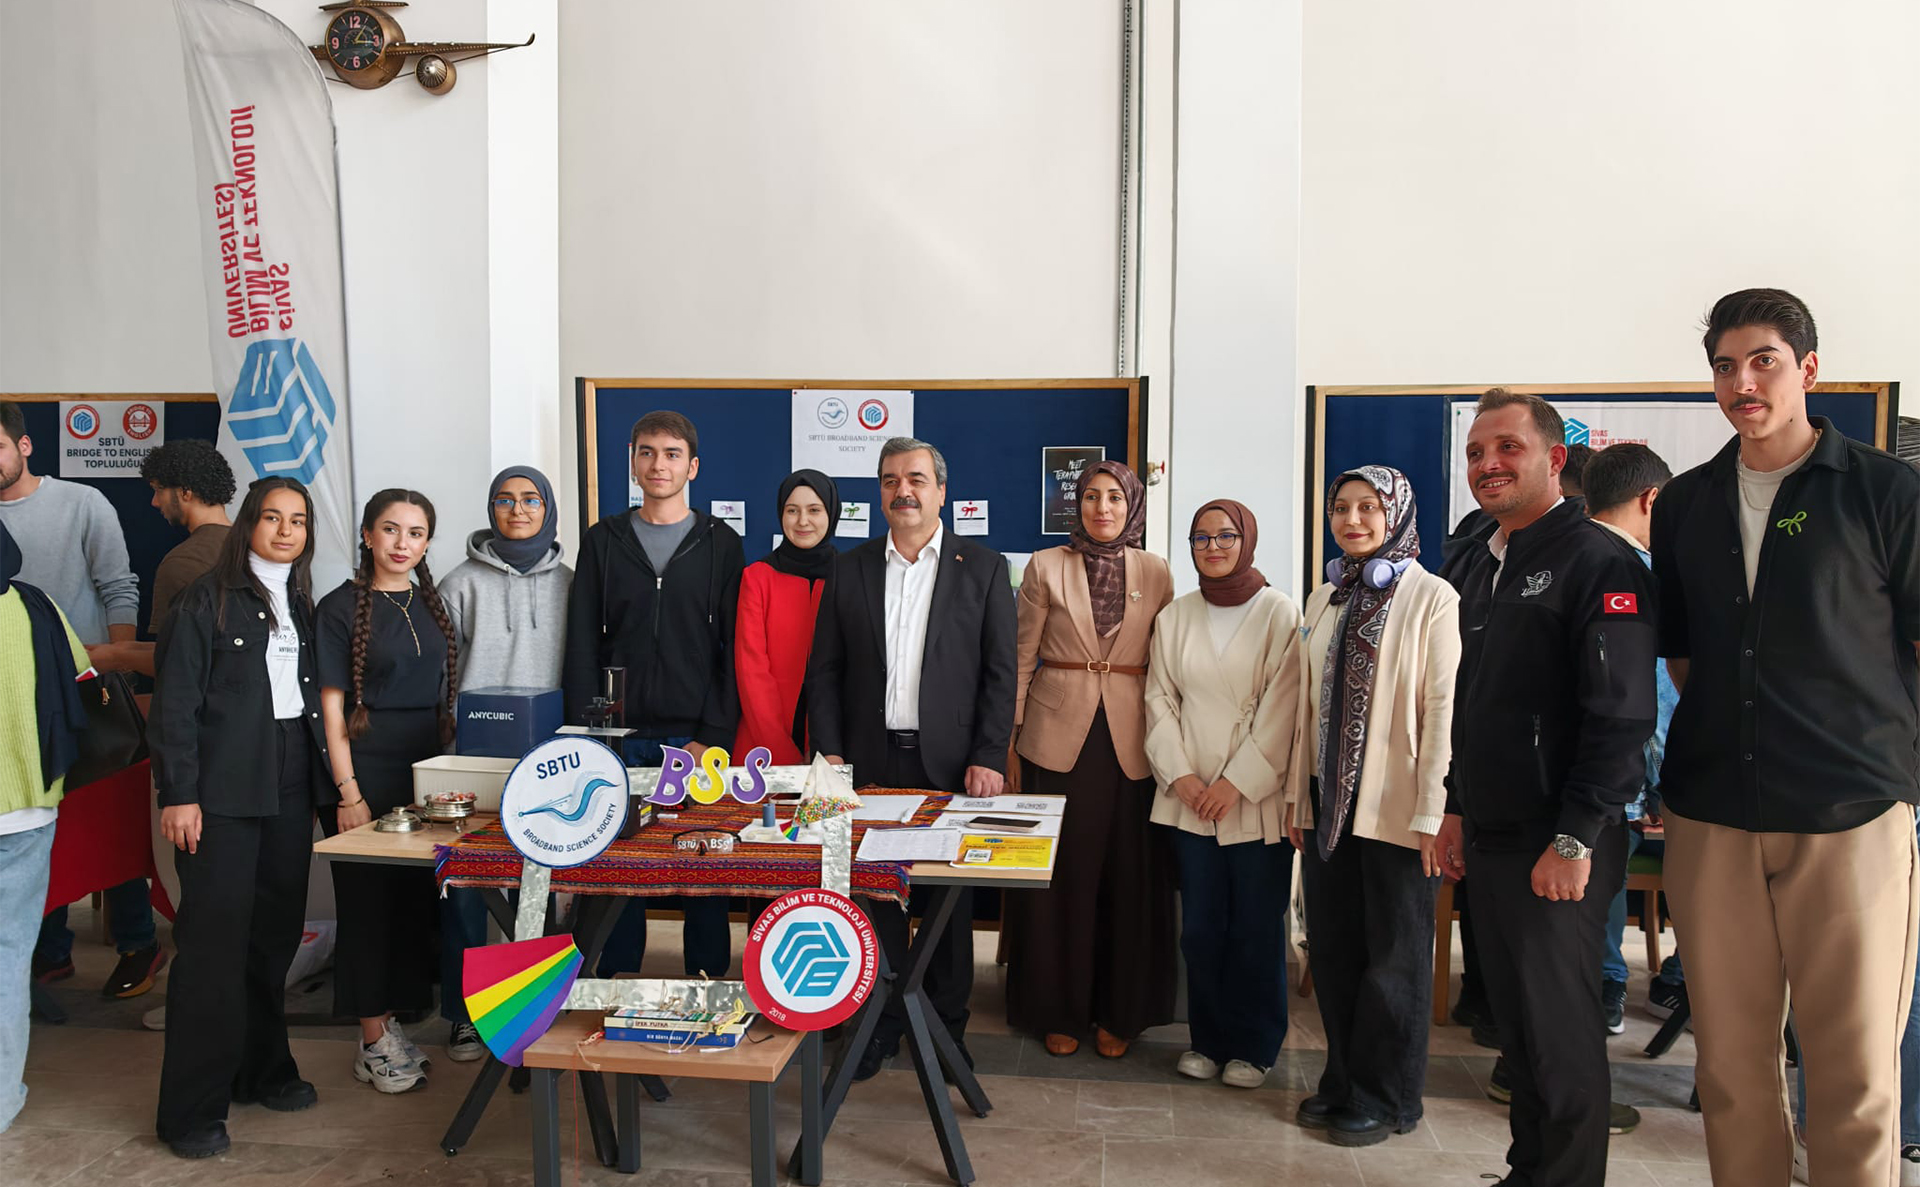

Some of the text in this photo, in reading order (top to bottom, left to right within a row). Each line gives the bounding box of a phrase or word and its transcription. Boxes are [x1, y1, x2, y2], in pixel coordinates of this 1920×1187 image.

[349, 15, 361, 29] 12
[331, 37, 340, 50] 9
[372, 34, 380, 47] 3
[352, 55, 361, 68] 6
[98, 435, 125, 447] SBTÜ
[66, 448, 151, 457] BRIDGE TO ENGLIS
[84, 458, 141, 468] TOPLULUĞU
[468, 711, 515, 721] ANYCUBIC
[536, 751, 581, 780] SBTU
[643, 744, 772, 807] BSS
[523, 828, 564, 853] BROADBAND
[566, 832, 598, 853] SCIENCE
[597, 803, 617, 835] SOCIETY
[752, 912, 775, 943] SİVAS
[772, 895, 800, 916] BİLİM
[801, 893, 816, 903] VE
[817, 893, 868, 930] TEKNOLOJİ
[768, 1006, 787, 1022] 2018
